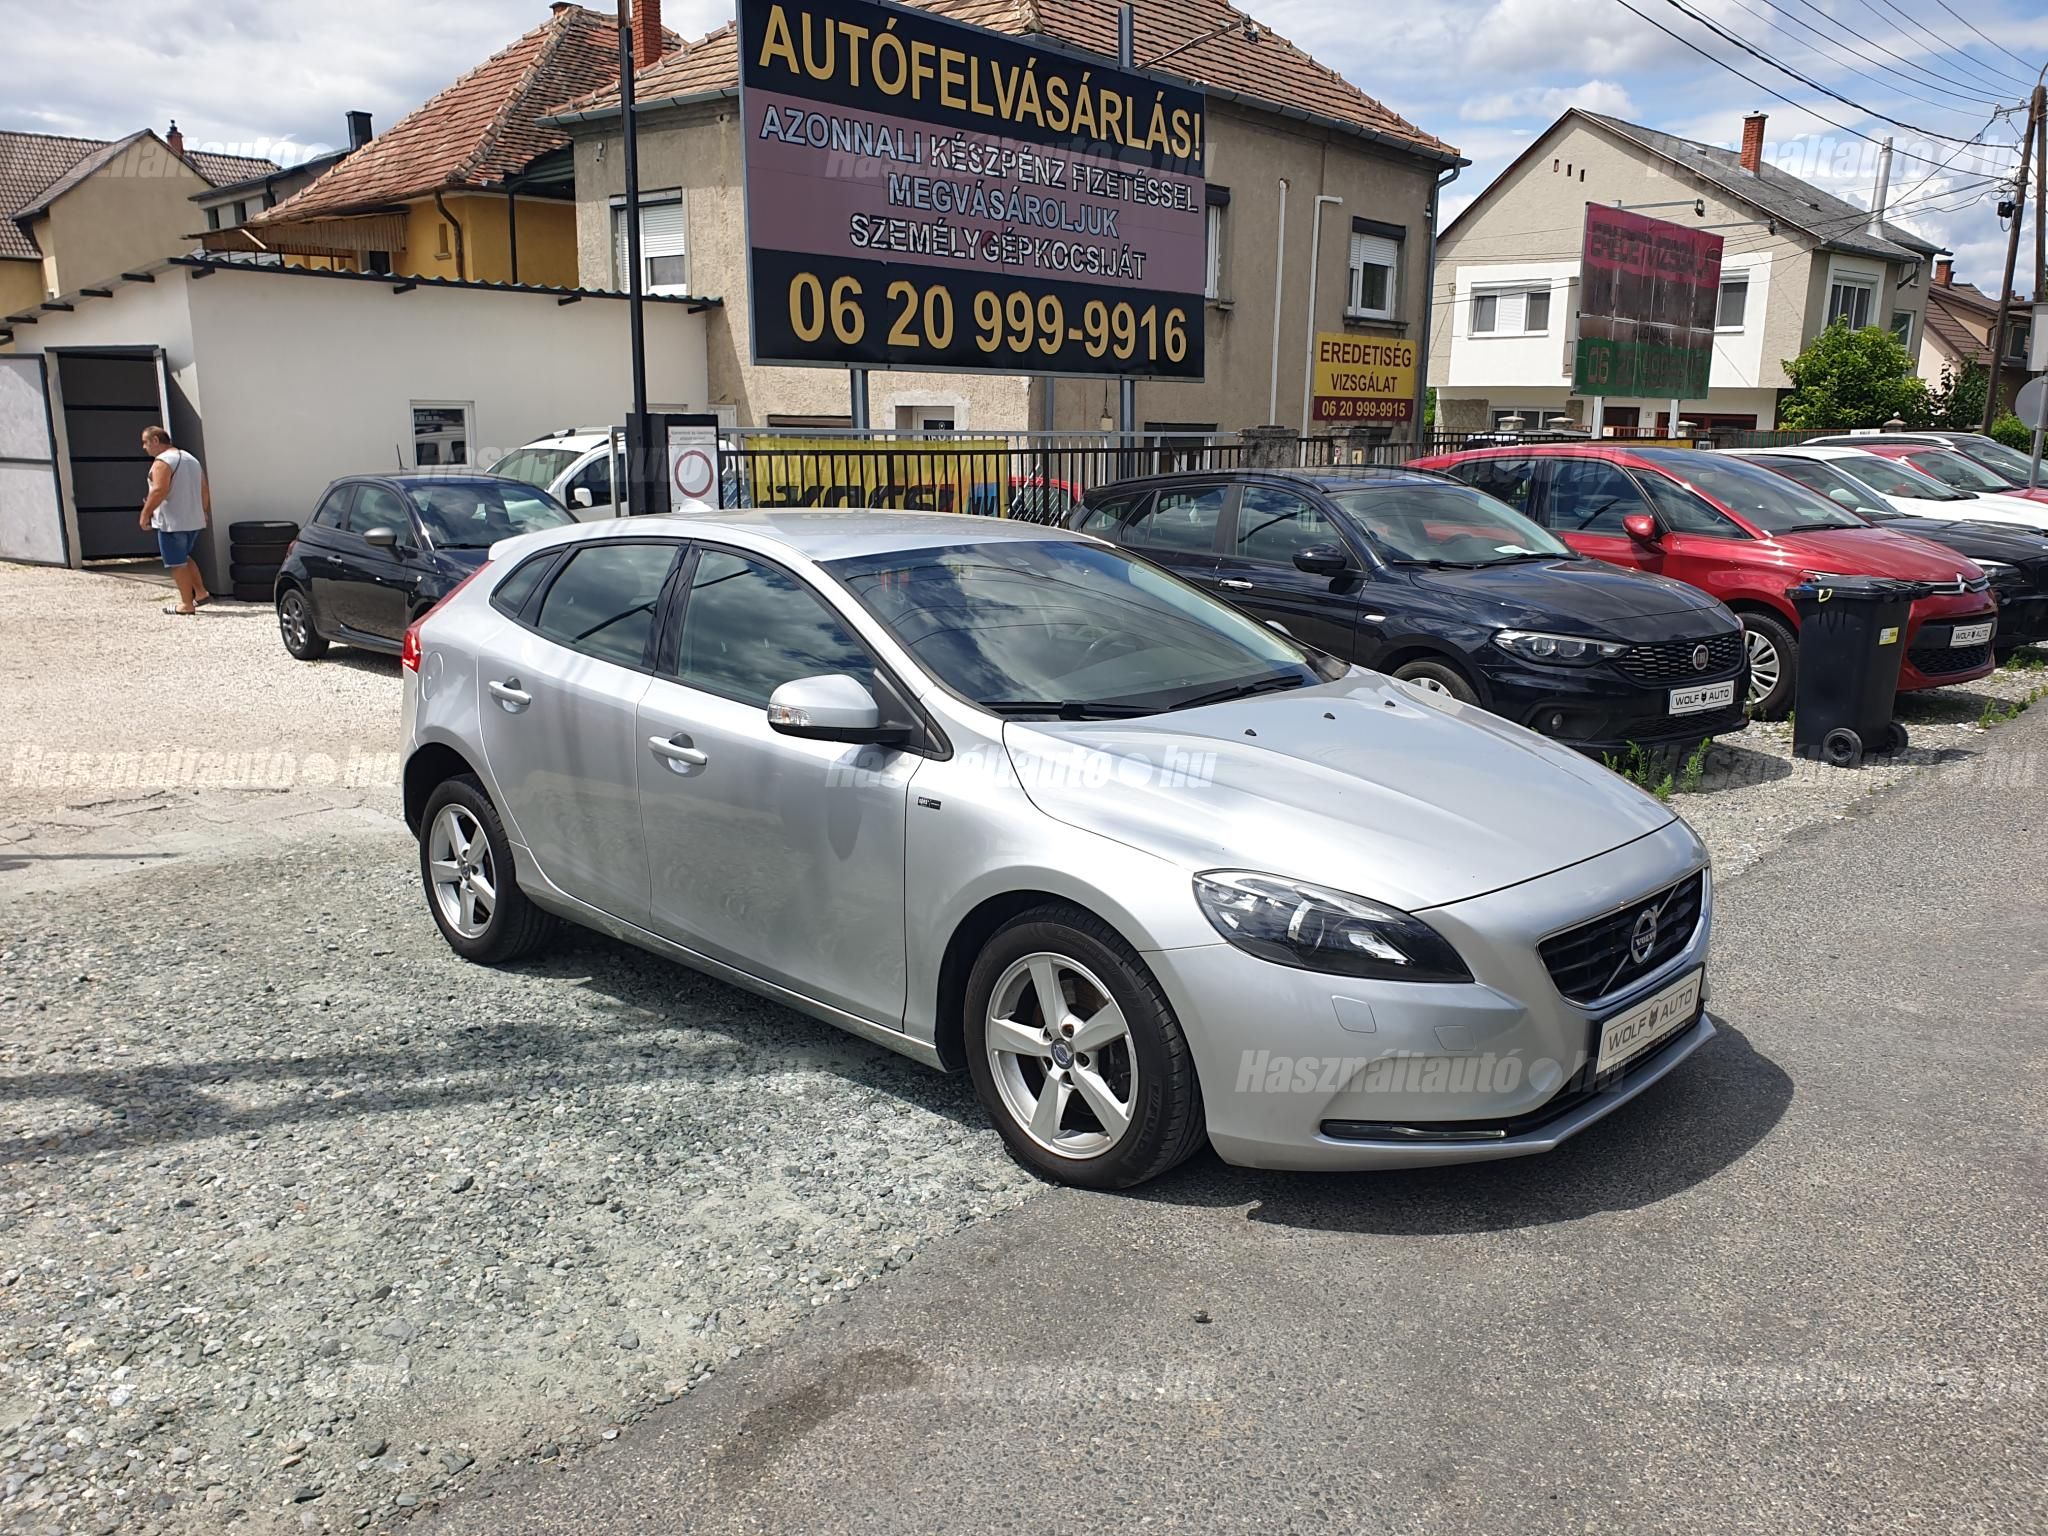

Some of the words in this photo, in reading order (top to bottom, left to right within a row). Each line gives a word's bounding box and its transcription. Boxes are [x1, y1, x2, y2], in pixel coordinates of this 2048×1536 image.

[758, 4, 1202, 161] AUTÓFELVÁSÁRLÁS!
[760, 105, 923, 165] AZONNALI
[930, 133, 1066, 191] KÉSZPÉNZ
[1071, 162, 1199, 213] FIZETÉSSEL
[888, 172, 1120, 239] MEGVÁSÁROLJUK
[849, 214, 1147, 280] SZEMÉLYGÉPKOCSIJÁT
[788, 271, 866, 346] 06
[886, 280, 955, 350] 20
[973, 289, 1187, 363] 999-9916
[1320, 341, 1411, 368] EREDETISÉG
[1331, 372, 1398, 393] VIZSGÁLAT
[1322, 400, 1336, 416] 06
[1339, 401, 1353, 417] 20
[1356, 401, 1406, 417] 999-9915
[1955, 631, 1971, 640] WOLF
[1675, 694, 1699, 706] WOLF
[1709, 689, 1730, 701] AUTO
[1609, 1015, 1647, 1051] WOLF
[1660, 988, 1693, 1022] AUTO
